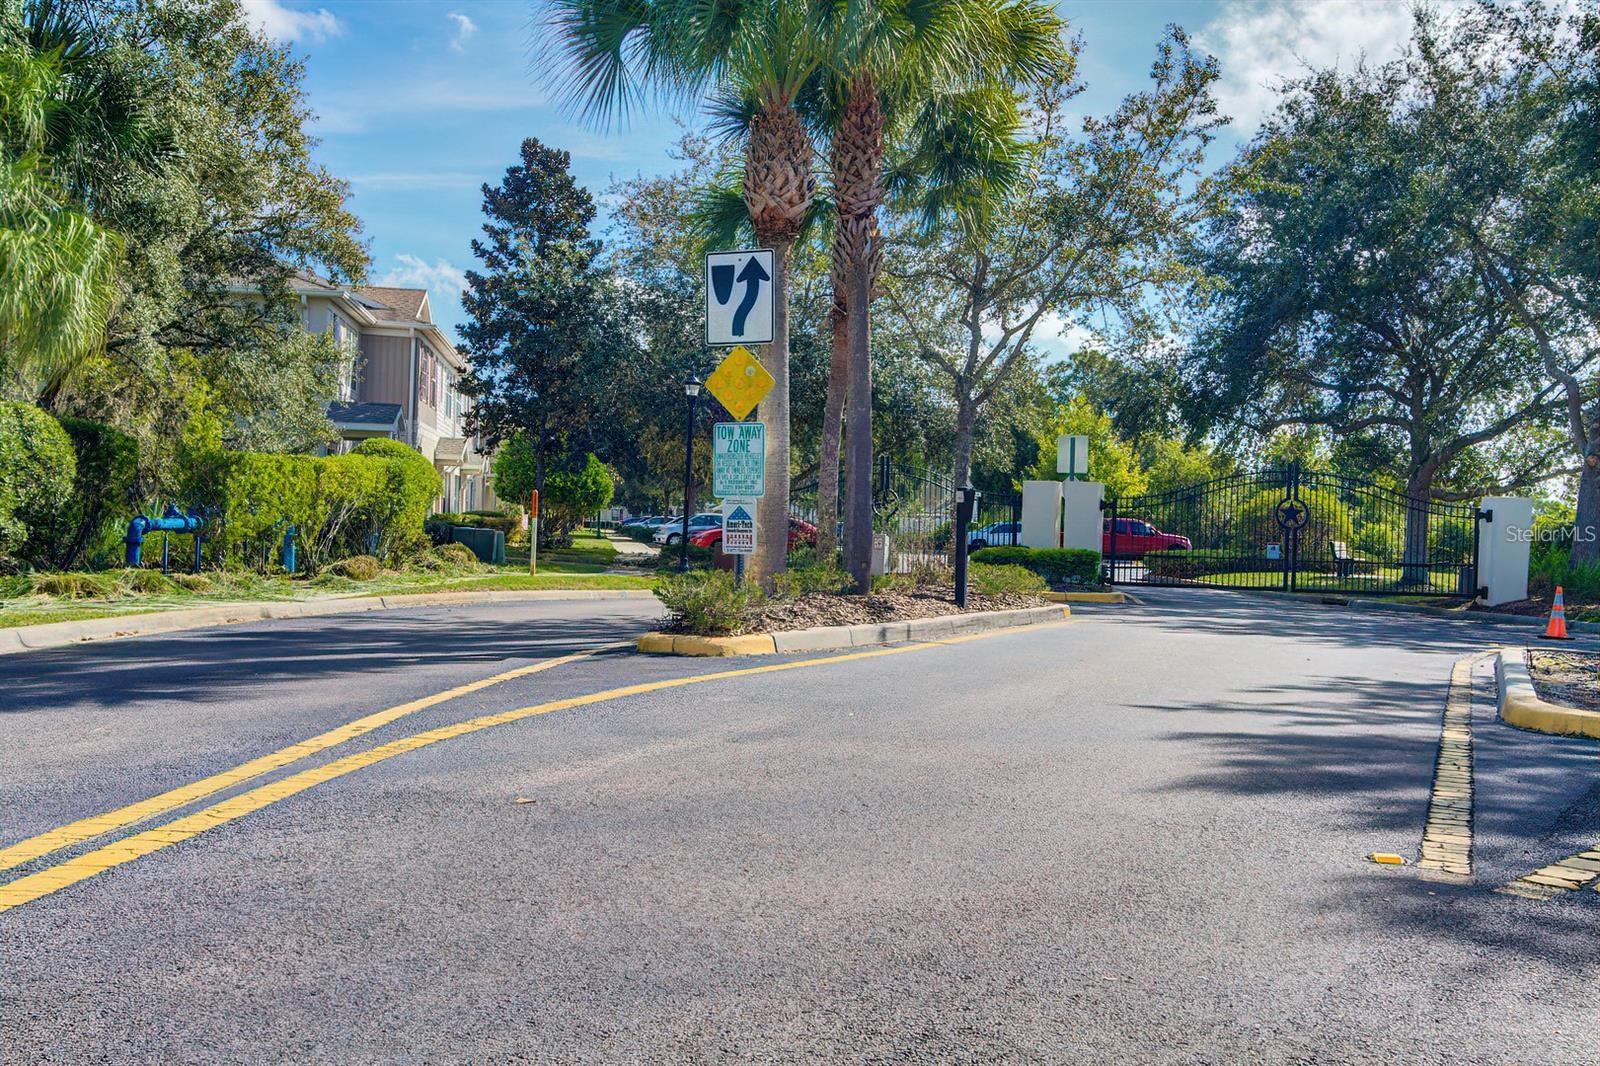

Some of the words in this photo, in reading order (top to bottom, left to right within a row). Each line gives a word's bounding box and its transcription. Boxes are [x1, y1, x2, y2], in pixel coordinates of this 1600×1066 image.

[717, 426, 735, 440] TOW
[739, 426, 762, 440] AWAY
[727, 439, 751, 453] ZONE
